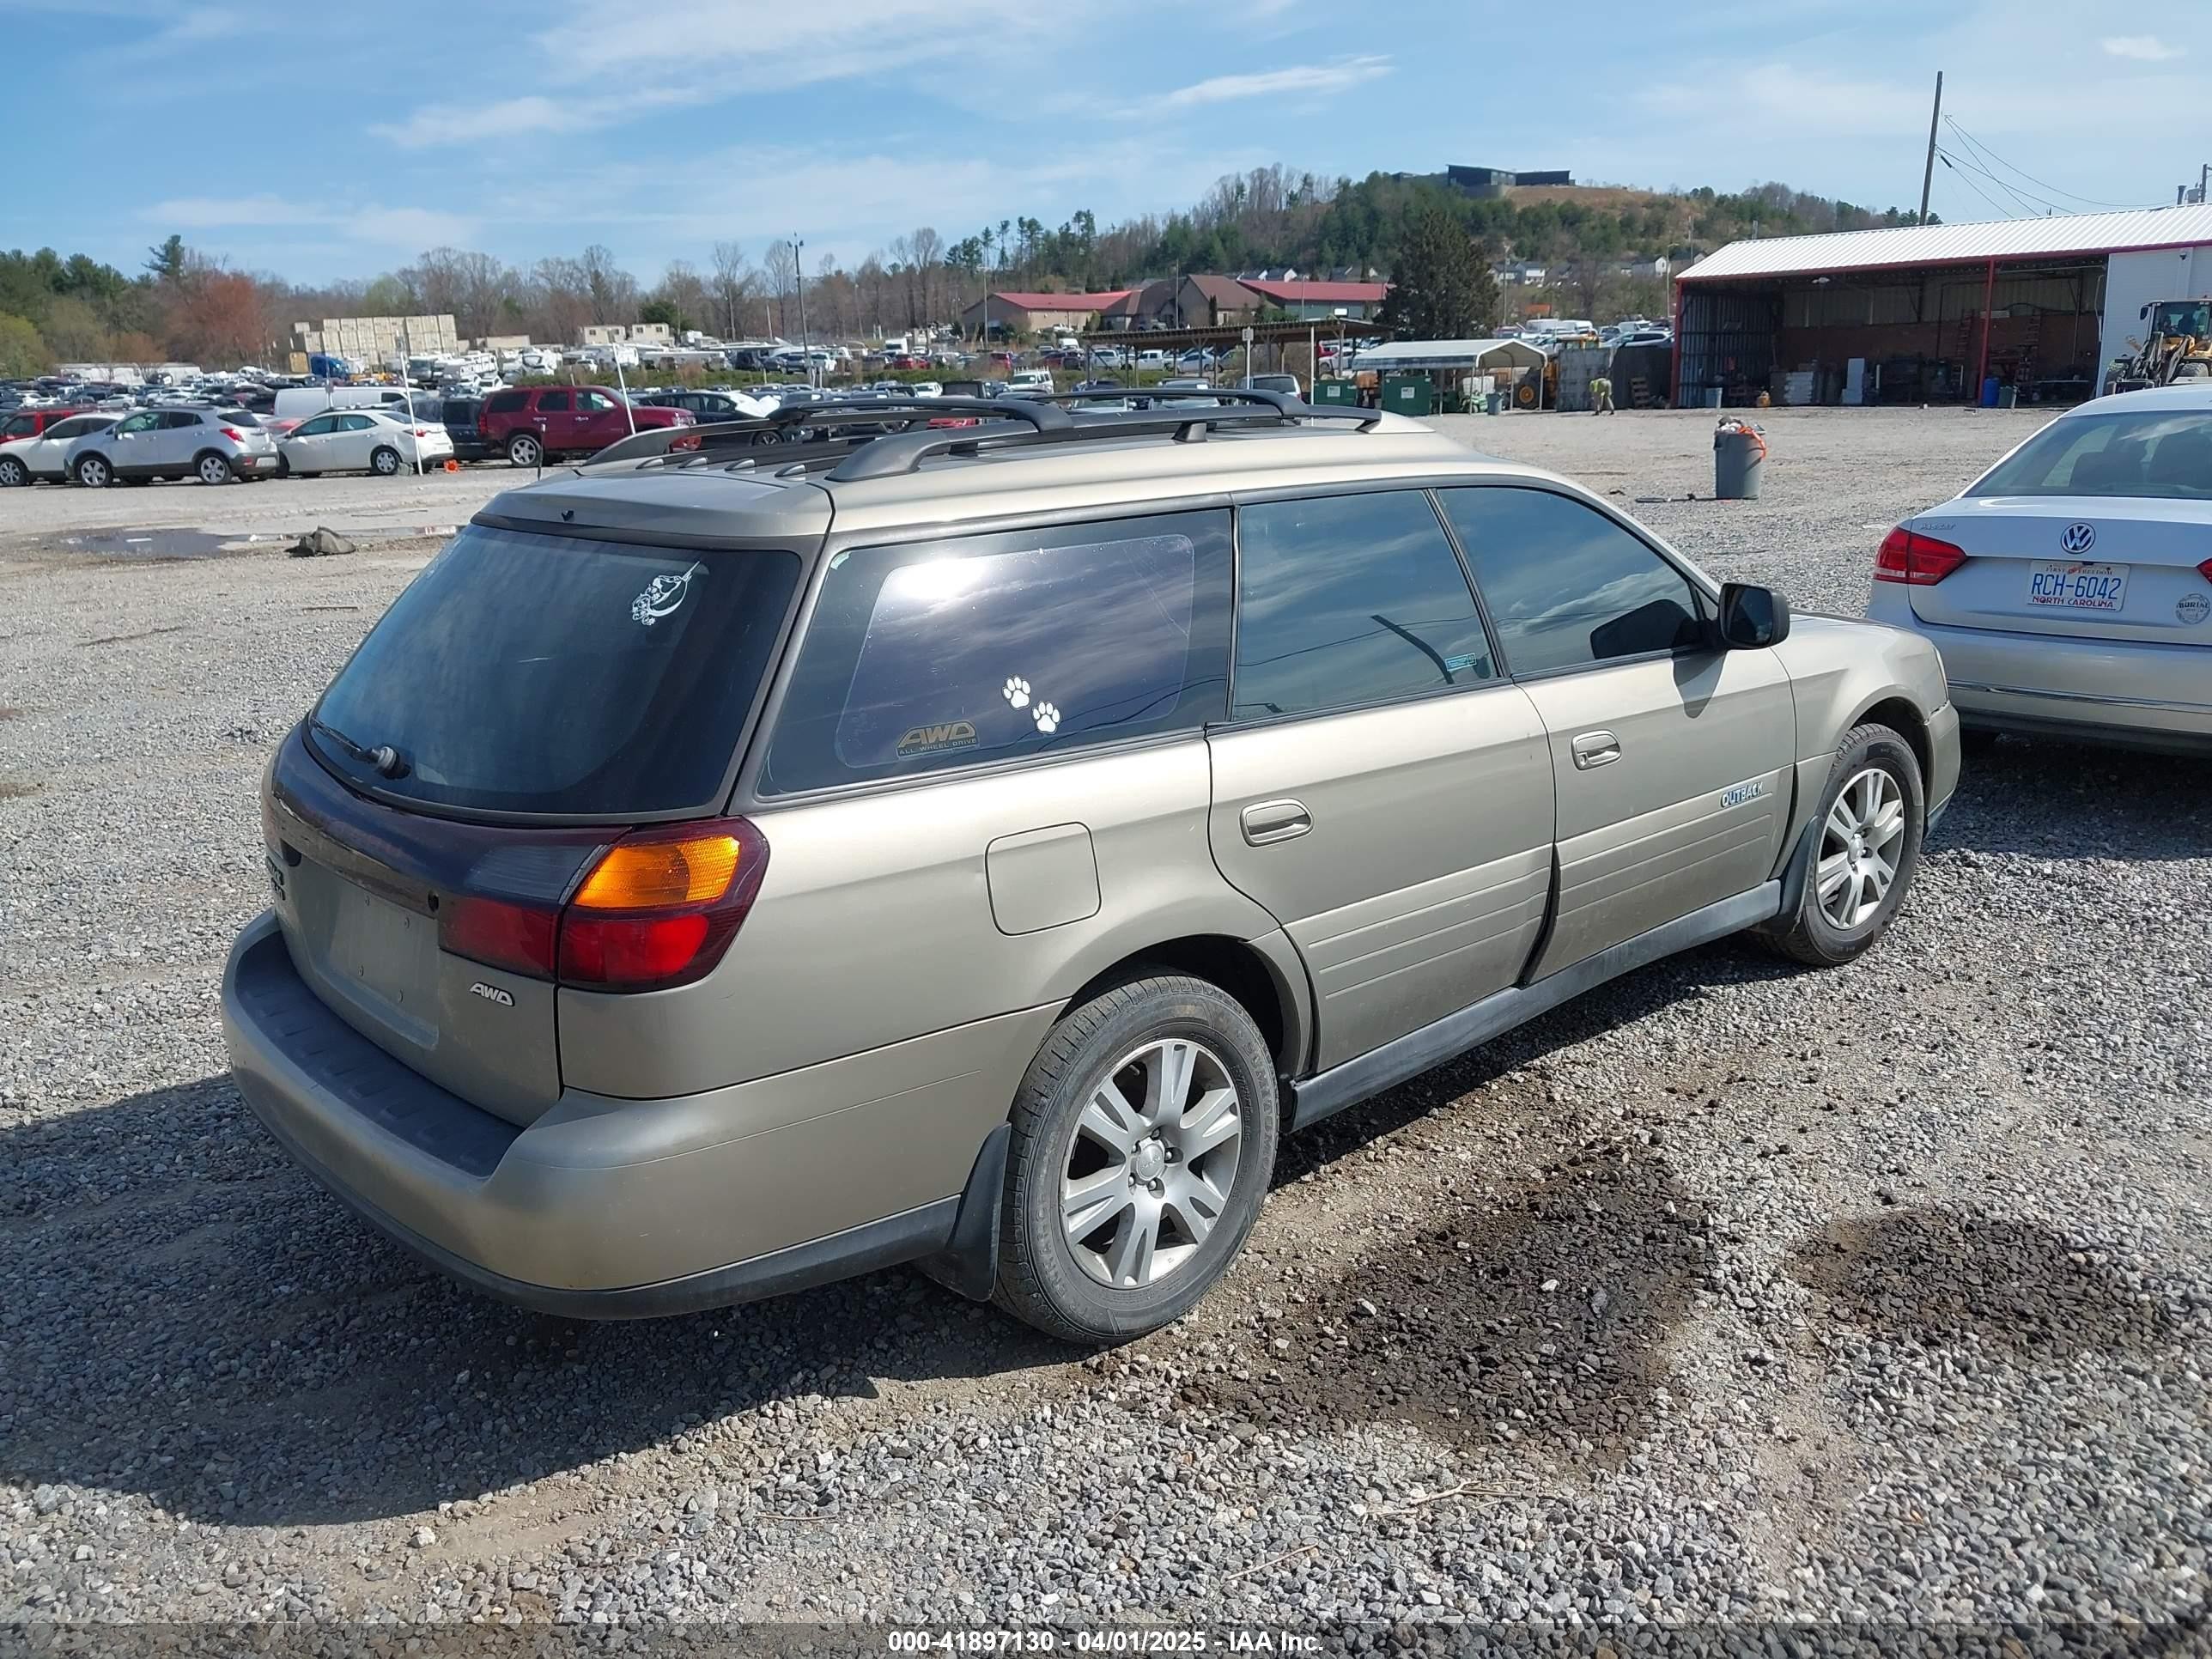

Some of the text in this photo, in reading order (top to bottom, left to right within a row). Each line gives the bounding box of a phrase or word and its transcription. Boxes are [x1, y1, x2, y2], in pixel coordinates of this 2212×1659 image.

[2031, 573, 2122, 600] RCH-6042
[2032, 595, 2113, 609] NORTH CAROLINA
[898, 721, 976, 749] AWD
[920, 741, 950, 752] WHEEL
[951, 738, 977, 747] DRIVE
[1720, 781, 1764, 808] OUTBACK
[469, 981, 515, 1007] AWD
